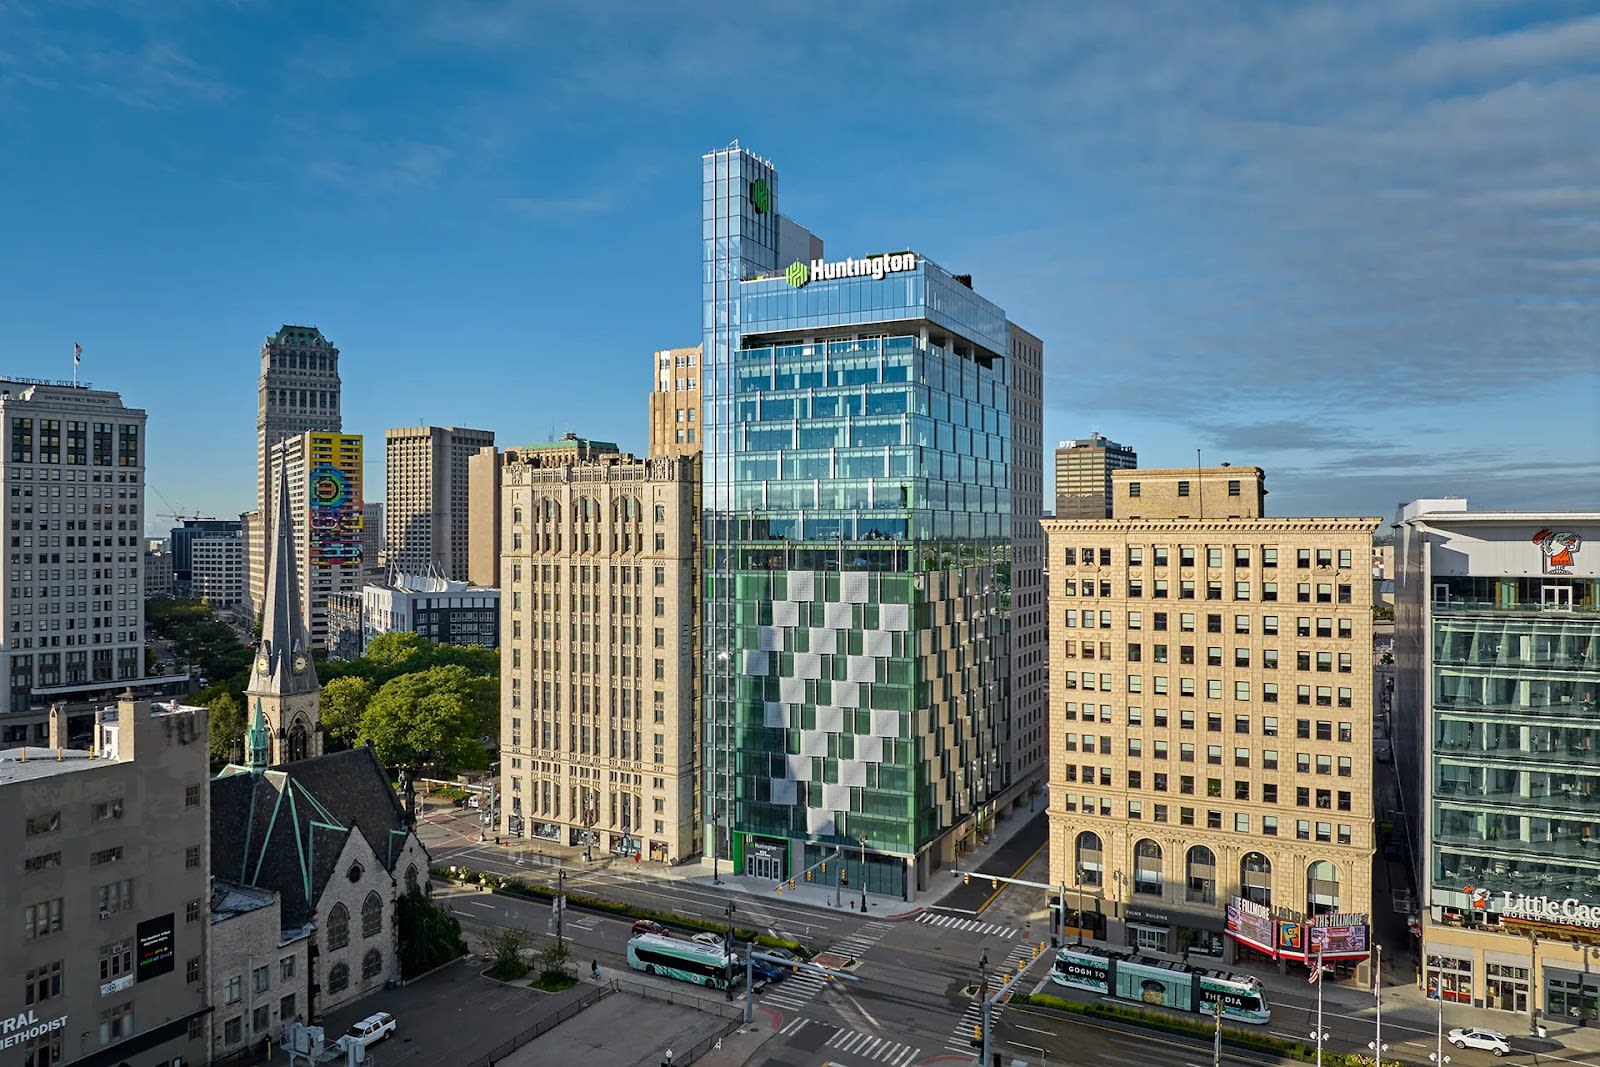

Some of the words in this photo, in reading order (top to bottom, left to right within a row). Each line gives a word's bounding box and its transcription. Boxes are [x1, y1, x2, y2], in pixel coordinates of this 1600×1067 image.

[810, 253, 915, 281] Huntington
[1059, 440, 1077, 448] DTE
[1241, 897, 1270, 921] FILLMORE
[1503, 890, 1560, 916] Little
[1562, 897, 1600, 921] Cae
[1315, 914, 1329, 928] THE
[1329, 912, 1363, 927] FILLMORE
[1502, 909, 1541, 921] WORLD
[1068, 965, 1092, 977] GOGH
[1094, 970, 1105, 979] TO
[1224, 996, 1242, 1006] DIA
